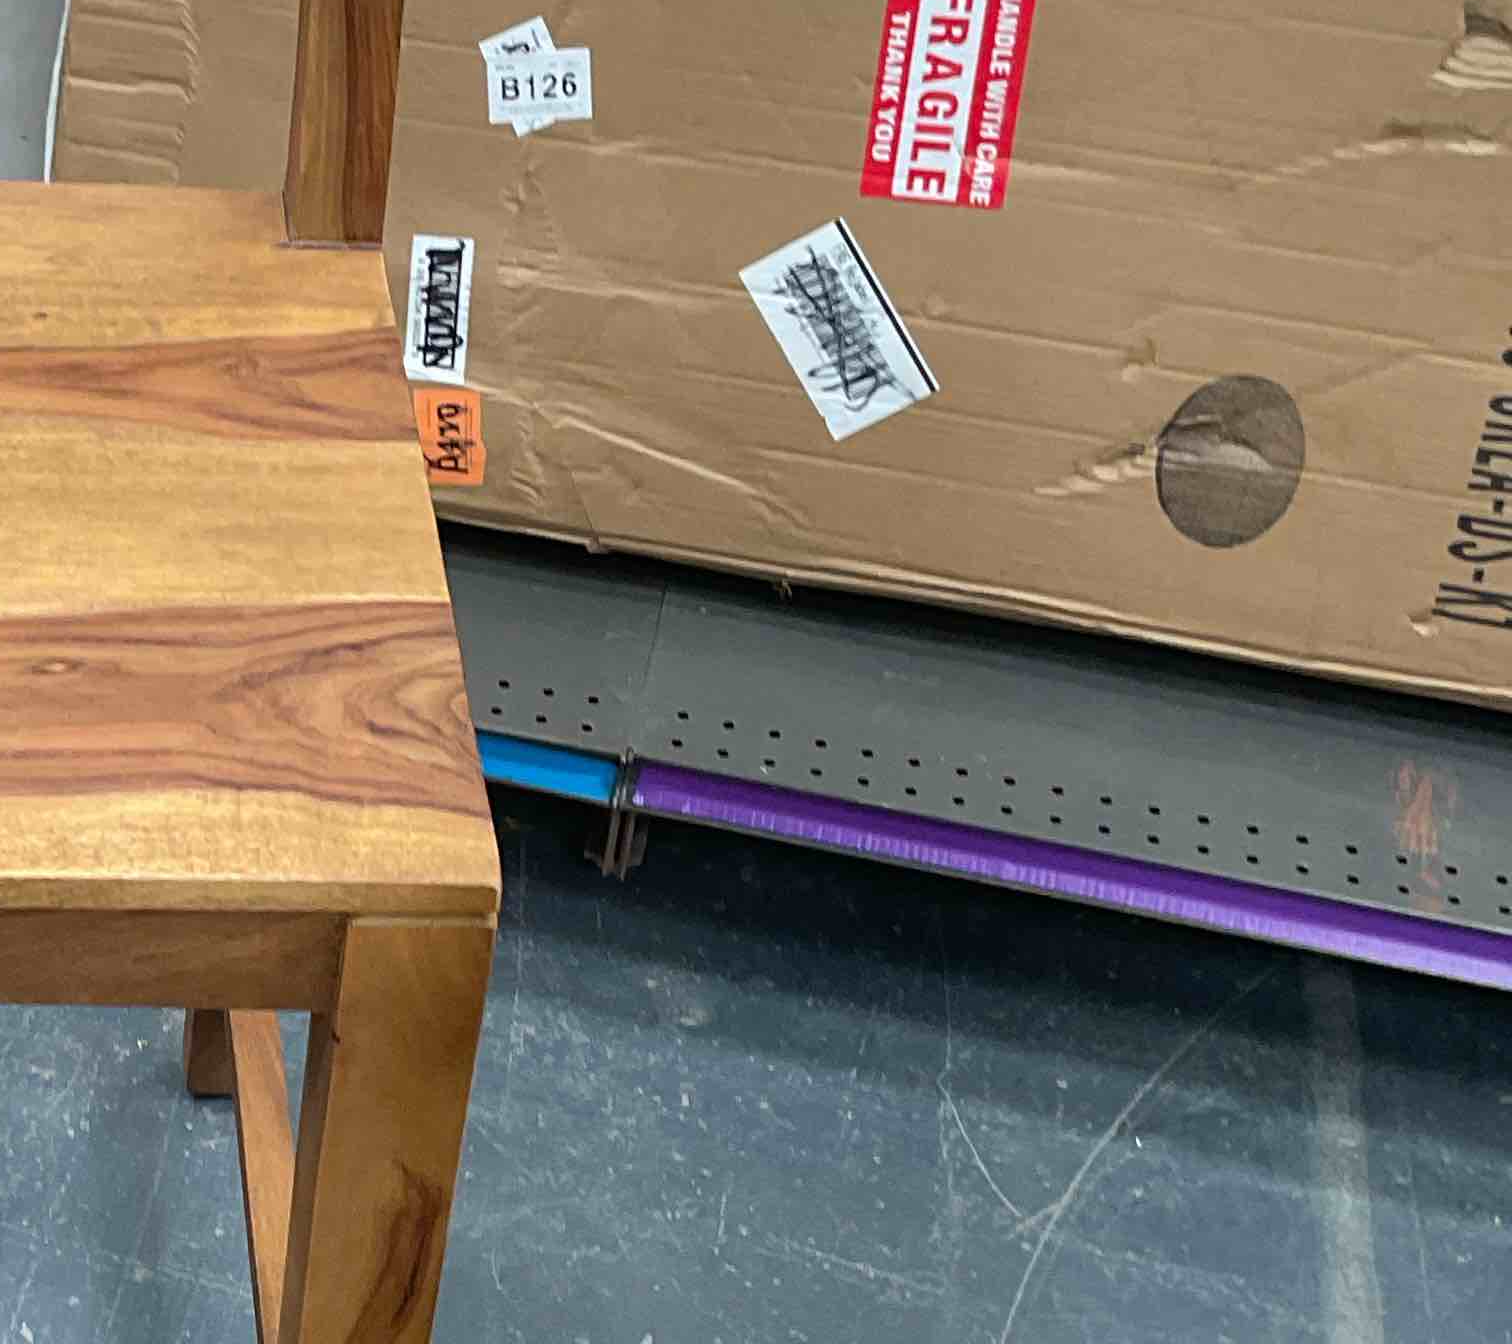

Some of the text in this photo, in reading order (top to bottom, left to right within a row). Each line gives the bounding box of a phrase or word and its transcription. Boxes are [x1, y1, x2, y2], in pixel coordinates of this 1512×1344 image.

[500, 71, 578, 101] B126
[871, 11, 911, 163] THANK YOU
[979, 80, 1008, 140] WITH
[969, 142, 998, 206] CARE
